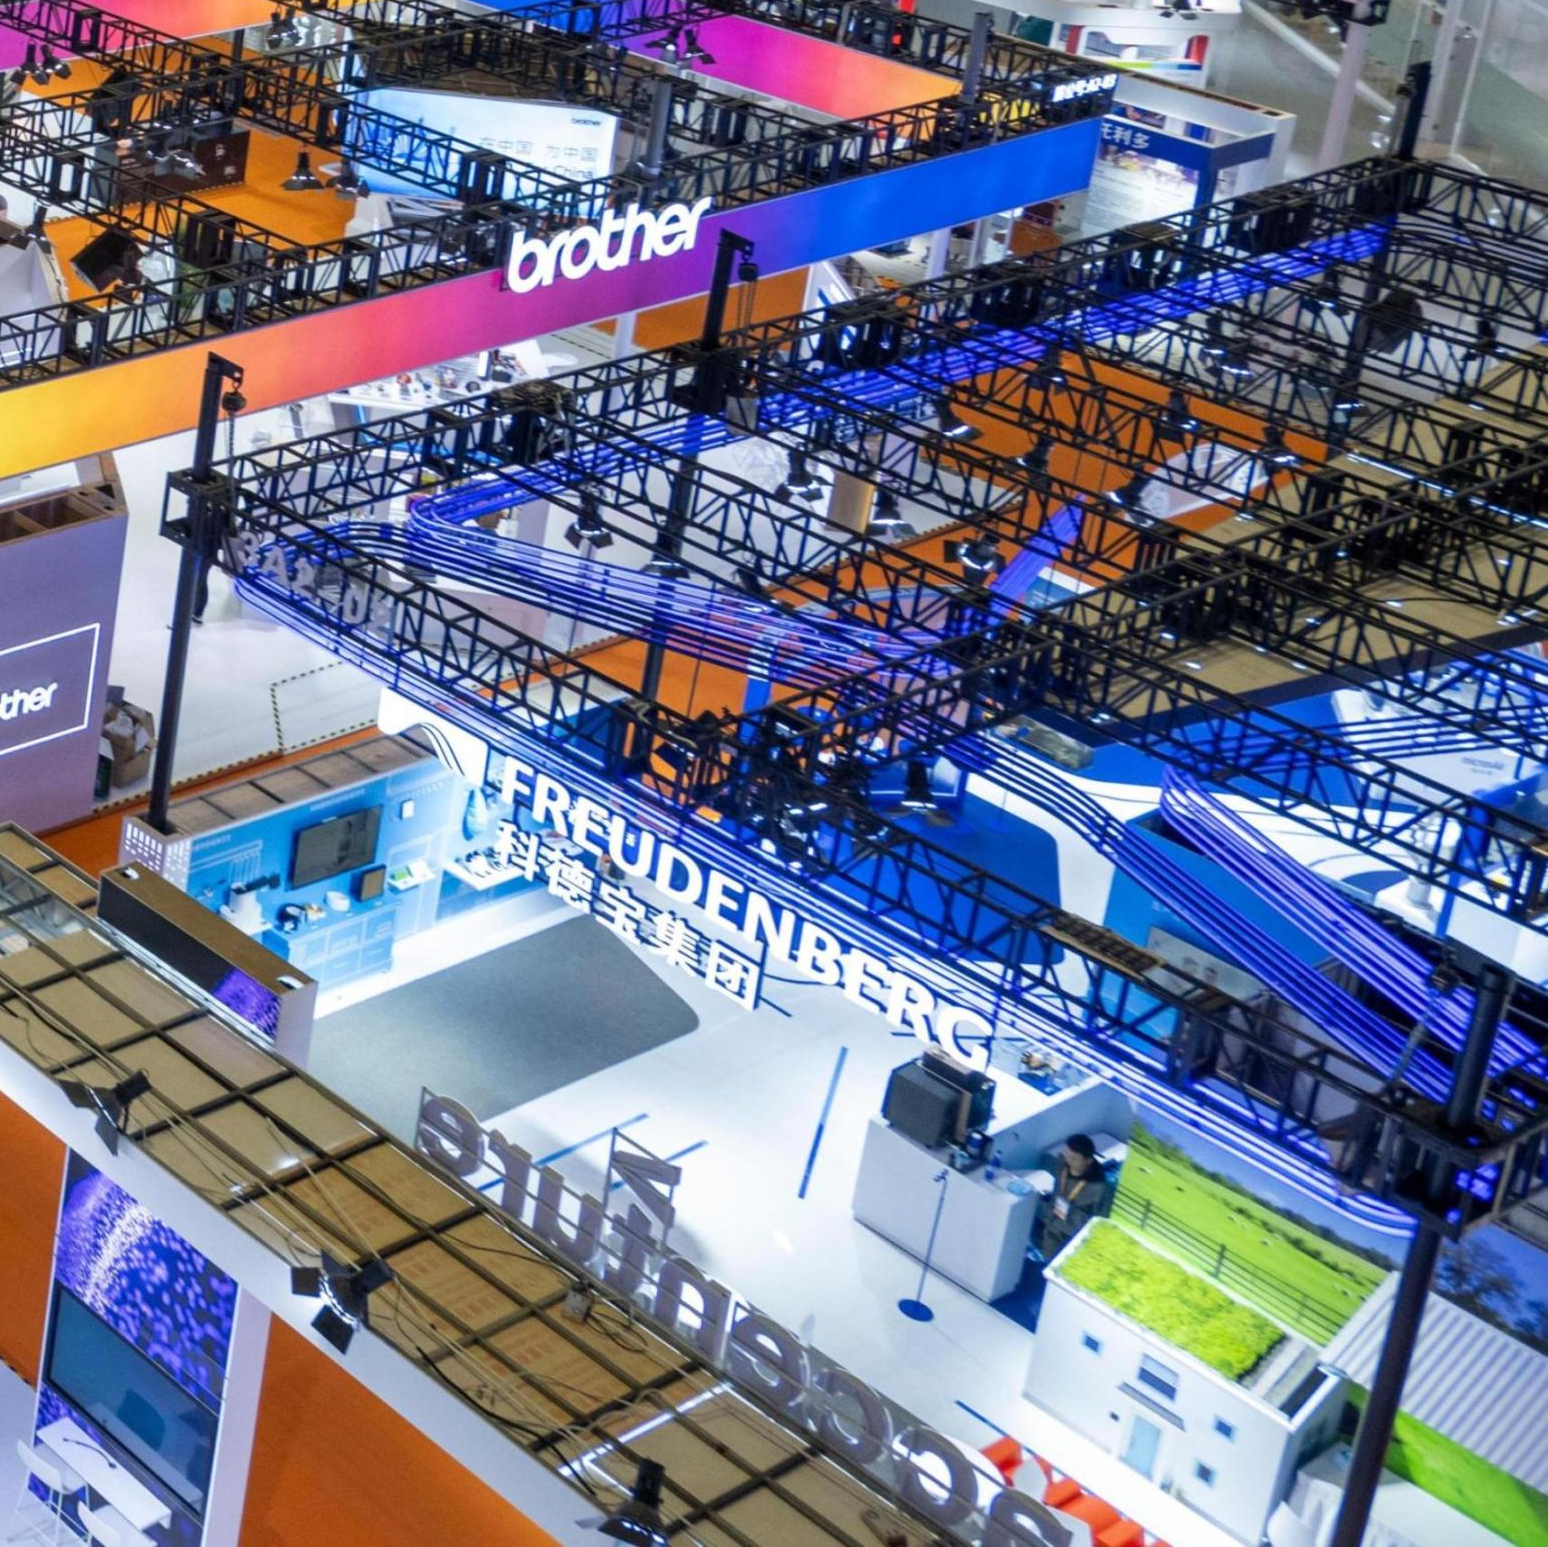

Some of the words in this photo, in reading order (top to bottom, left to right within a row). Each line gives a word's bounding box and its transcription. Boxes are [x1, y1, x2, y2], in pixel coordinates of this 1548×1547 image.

[506, 195, 712, 295] brother
[495, 819, 764, 1012] 科德宝集团
[503, 755, 994, 1070] FREUDENBERG
